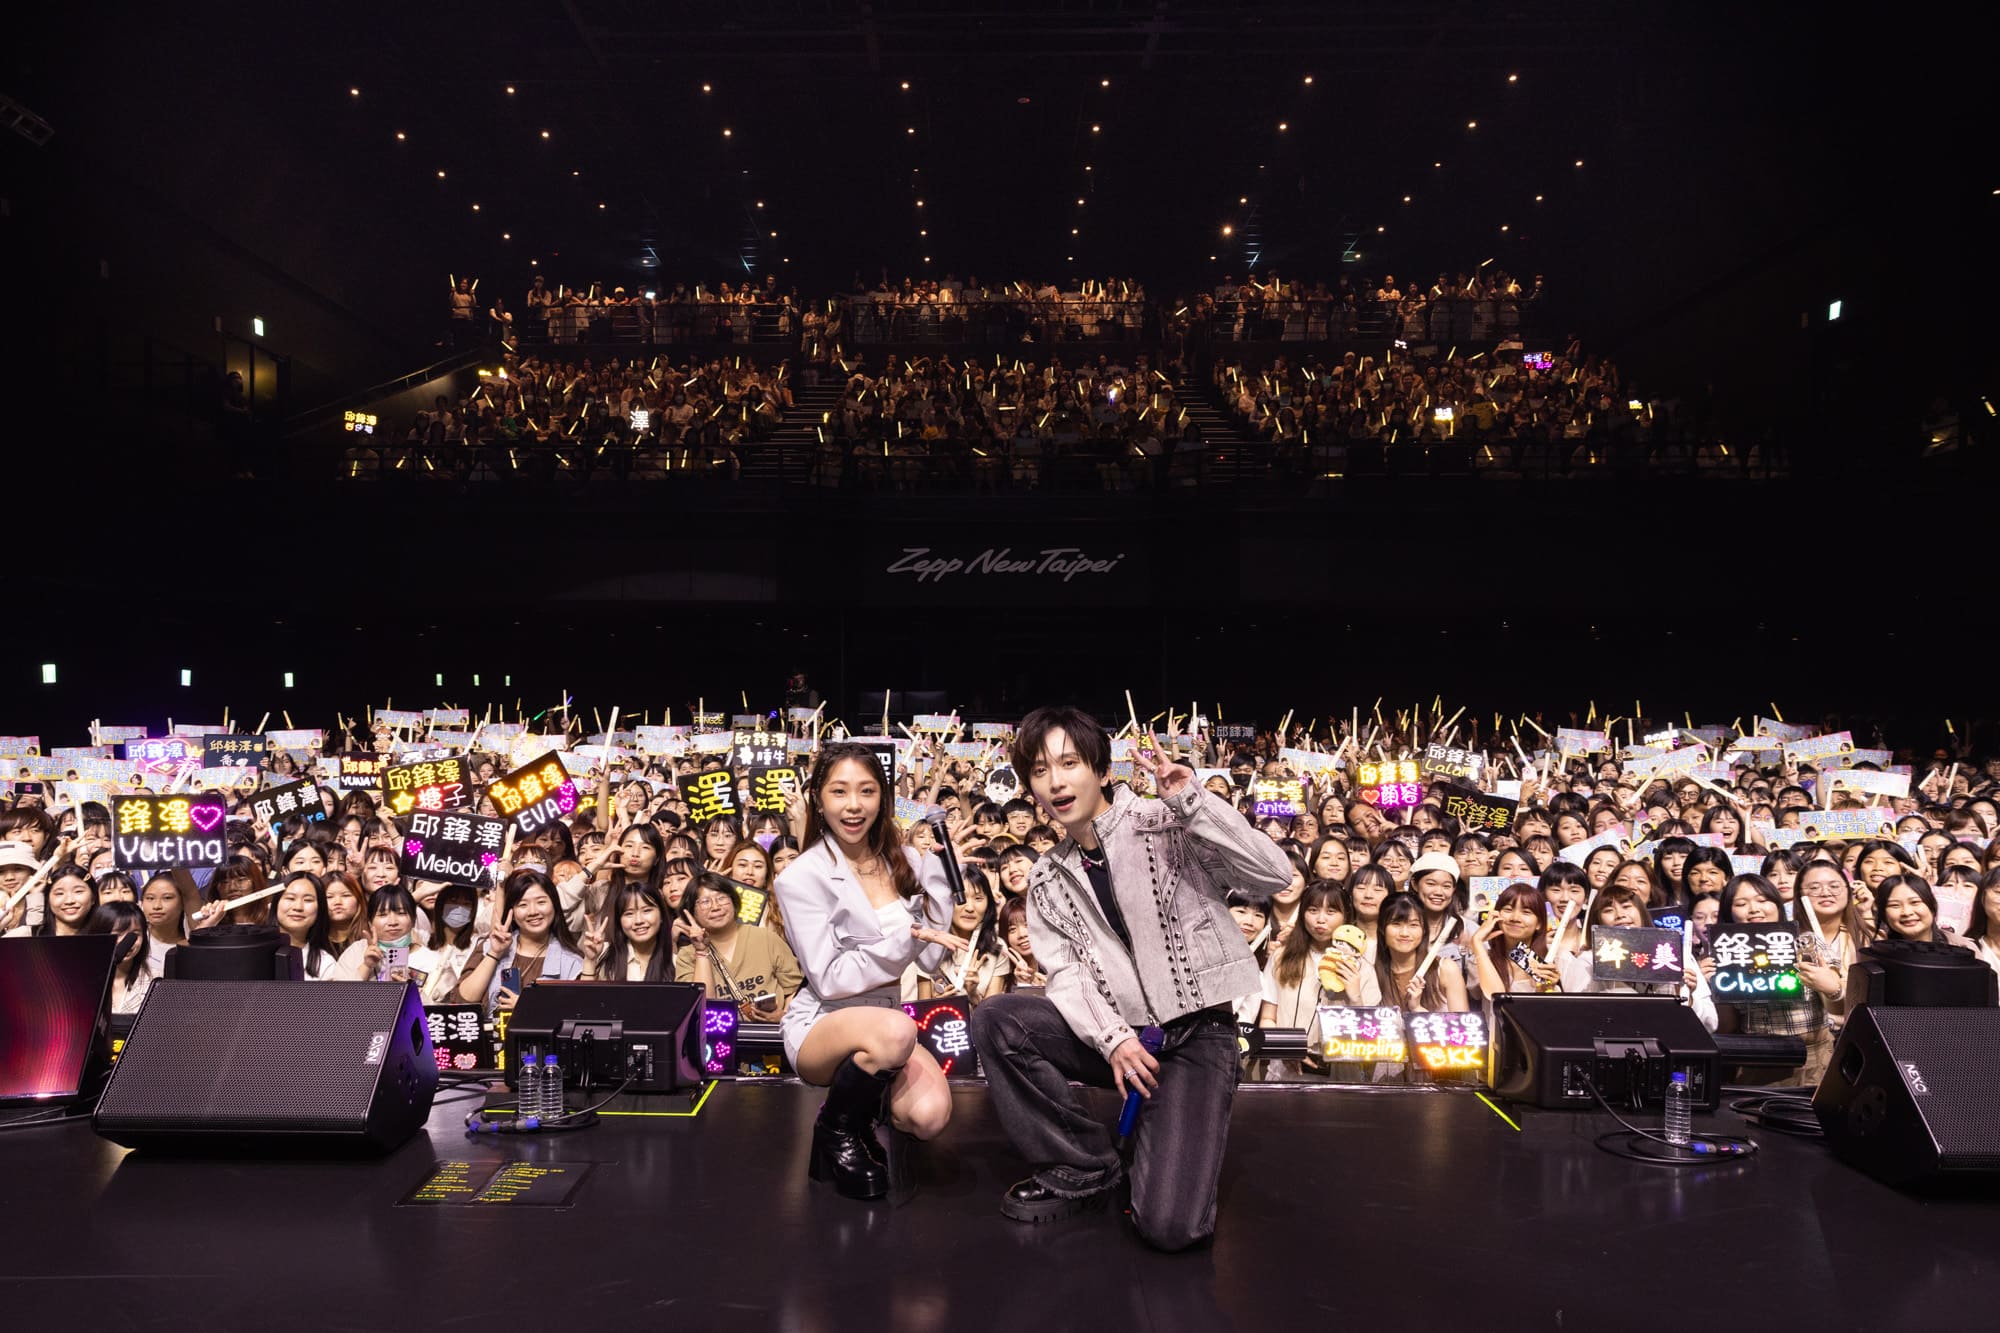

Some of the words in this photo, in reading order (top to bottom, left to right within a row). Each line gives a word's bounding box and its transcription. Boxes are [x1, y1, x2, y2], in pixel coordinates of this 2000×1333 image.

[886, 548, 963, 582] Zepp
[964, 548, 1036, 574] New
[1036, 548, 1125, 582] Taipei
[209, 739, 252, 753] 邱鋒澤
[387, 760, 461, 790] 邱鋒澤
[118, 800, 190, 833] 鋒澤
[254, 784, 320, 819] 邱鋒澤
[517, 798, 562, 832] EVA
[1446, 796, 1510, 829] 邱鋒澤
[410, 813, 503, 849] 邱鋒澤
[119, 836, 222, 863] Yuting
[415, 852, 484, 882] Melody
[1651, 942, 1682, 971] 美
[1714, 931, 1795, 967] 鋒澤
[1322, 1007, 1399, 1041] 鋒澤
[1410, 1013, 1487, 1048] 鋒澤
[366, 1035, 384, 1062] NEXO
[1326, 1038, 1404, 1061] Dumpling
[1904, 1064, 1927, 1092] NEXO
